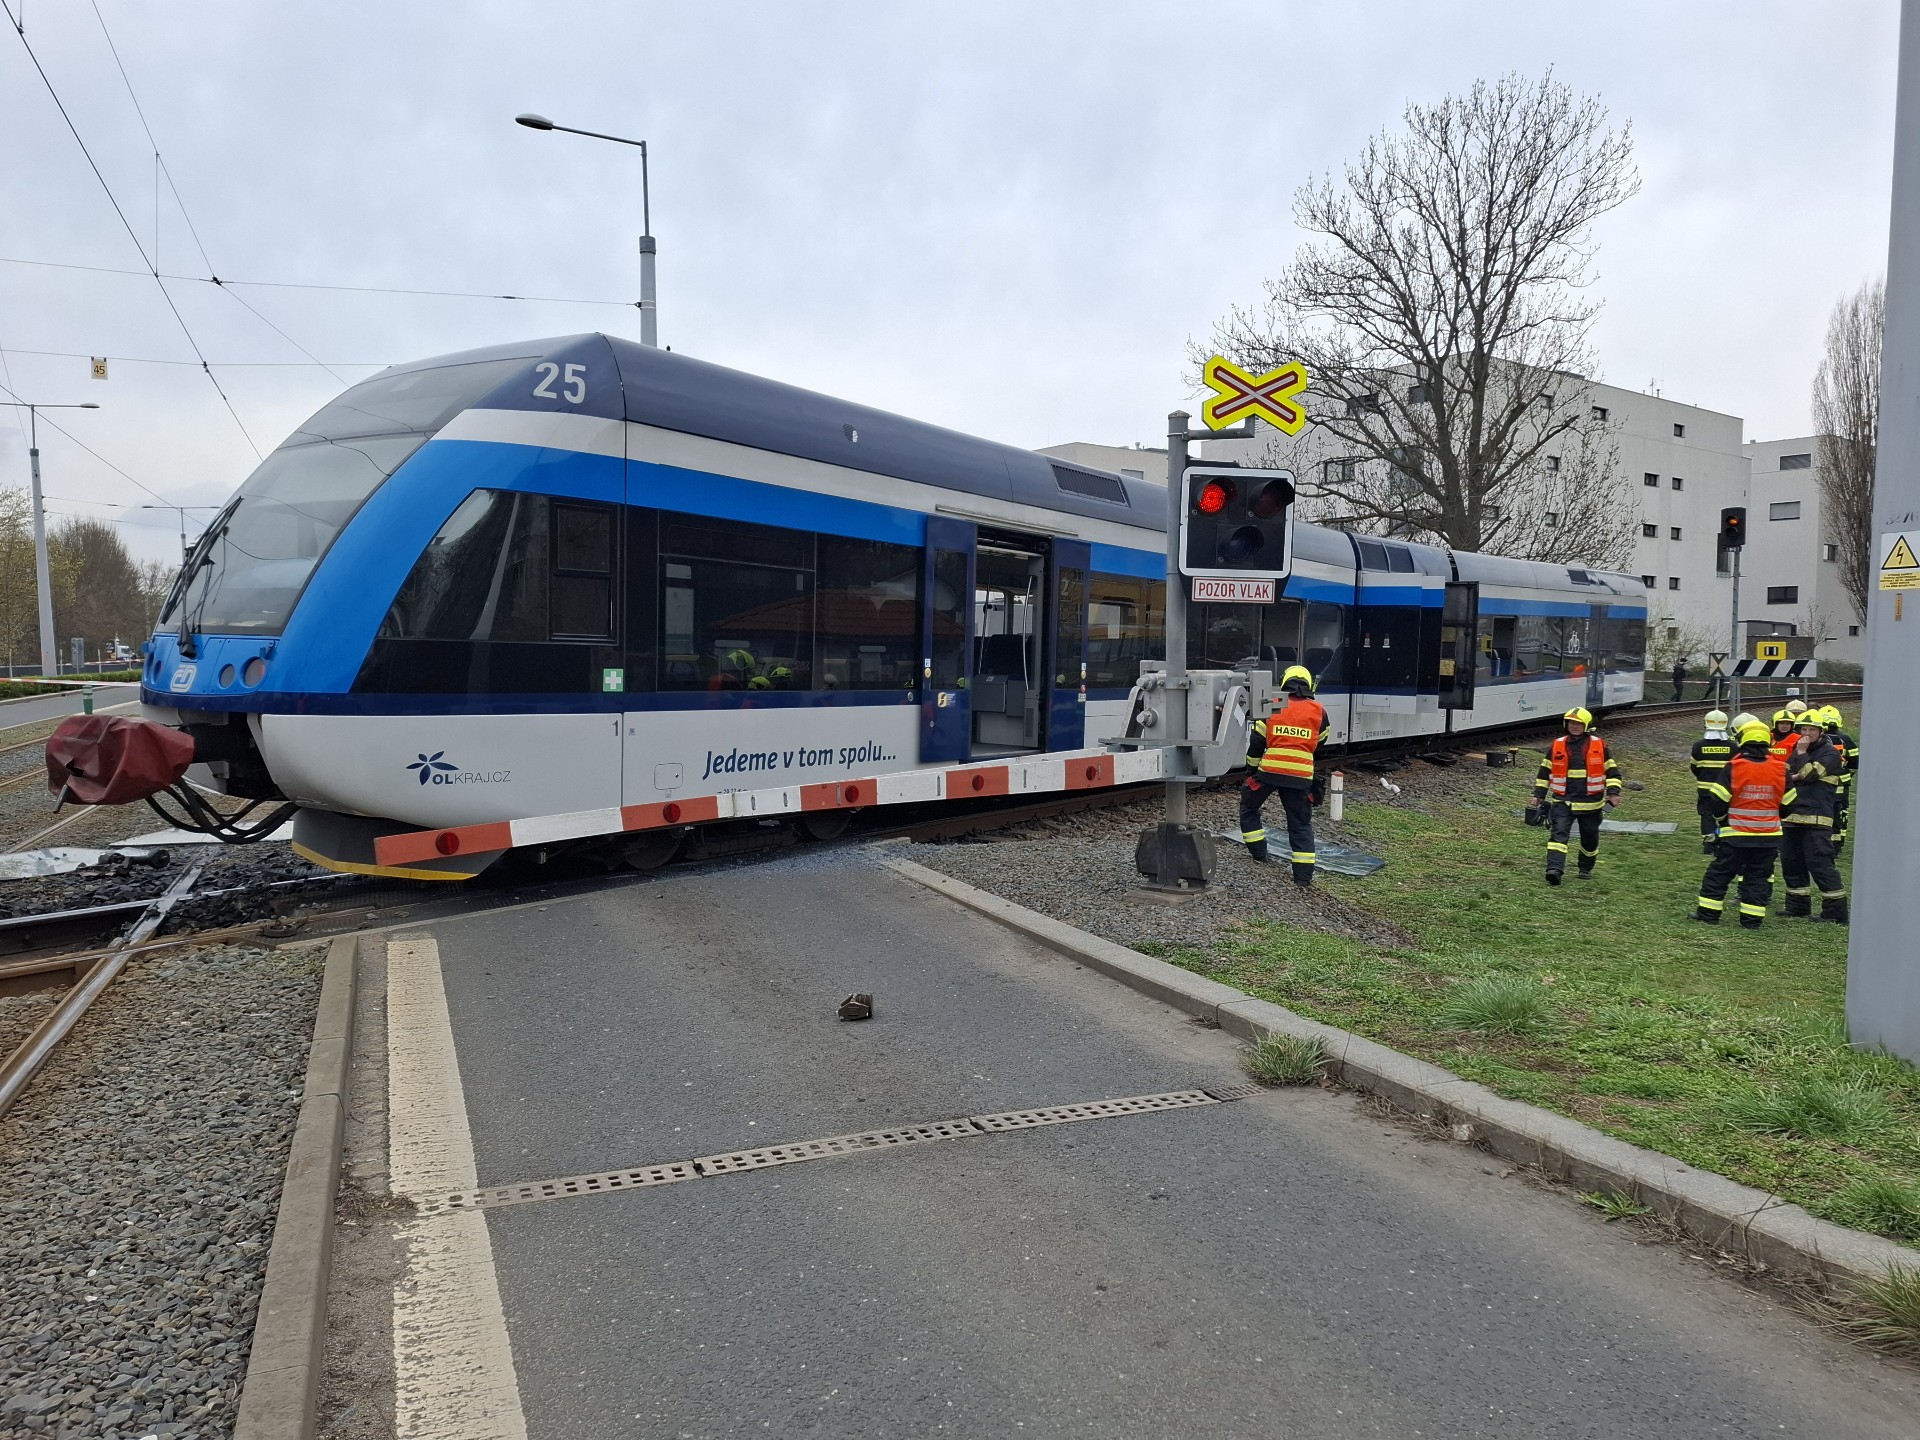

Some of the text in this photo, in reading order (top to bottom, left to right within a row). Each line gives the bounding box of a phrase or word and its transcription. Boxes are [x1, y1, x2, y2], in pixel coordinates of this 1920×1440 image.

[93, 365, 105, 375] 45
[533, 361, 586, 404] 25
[1198, 582, 1269, 599] POZOR VLAK
[611, 719, 619, 737] 1
[702, 740, 897, 781] Jedeme v tom spolu...
[432, 771, 511, 785] OLKRAJ.CZ
